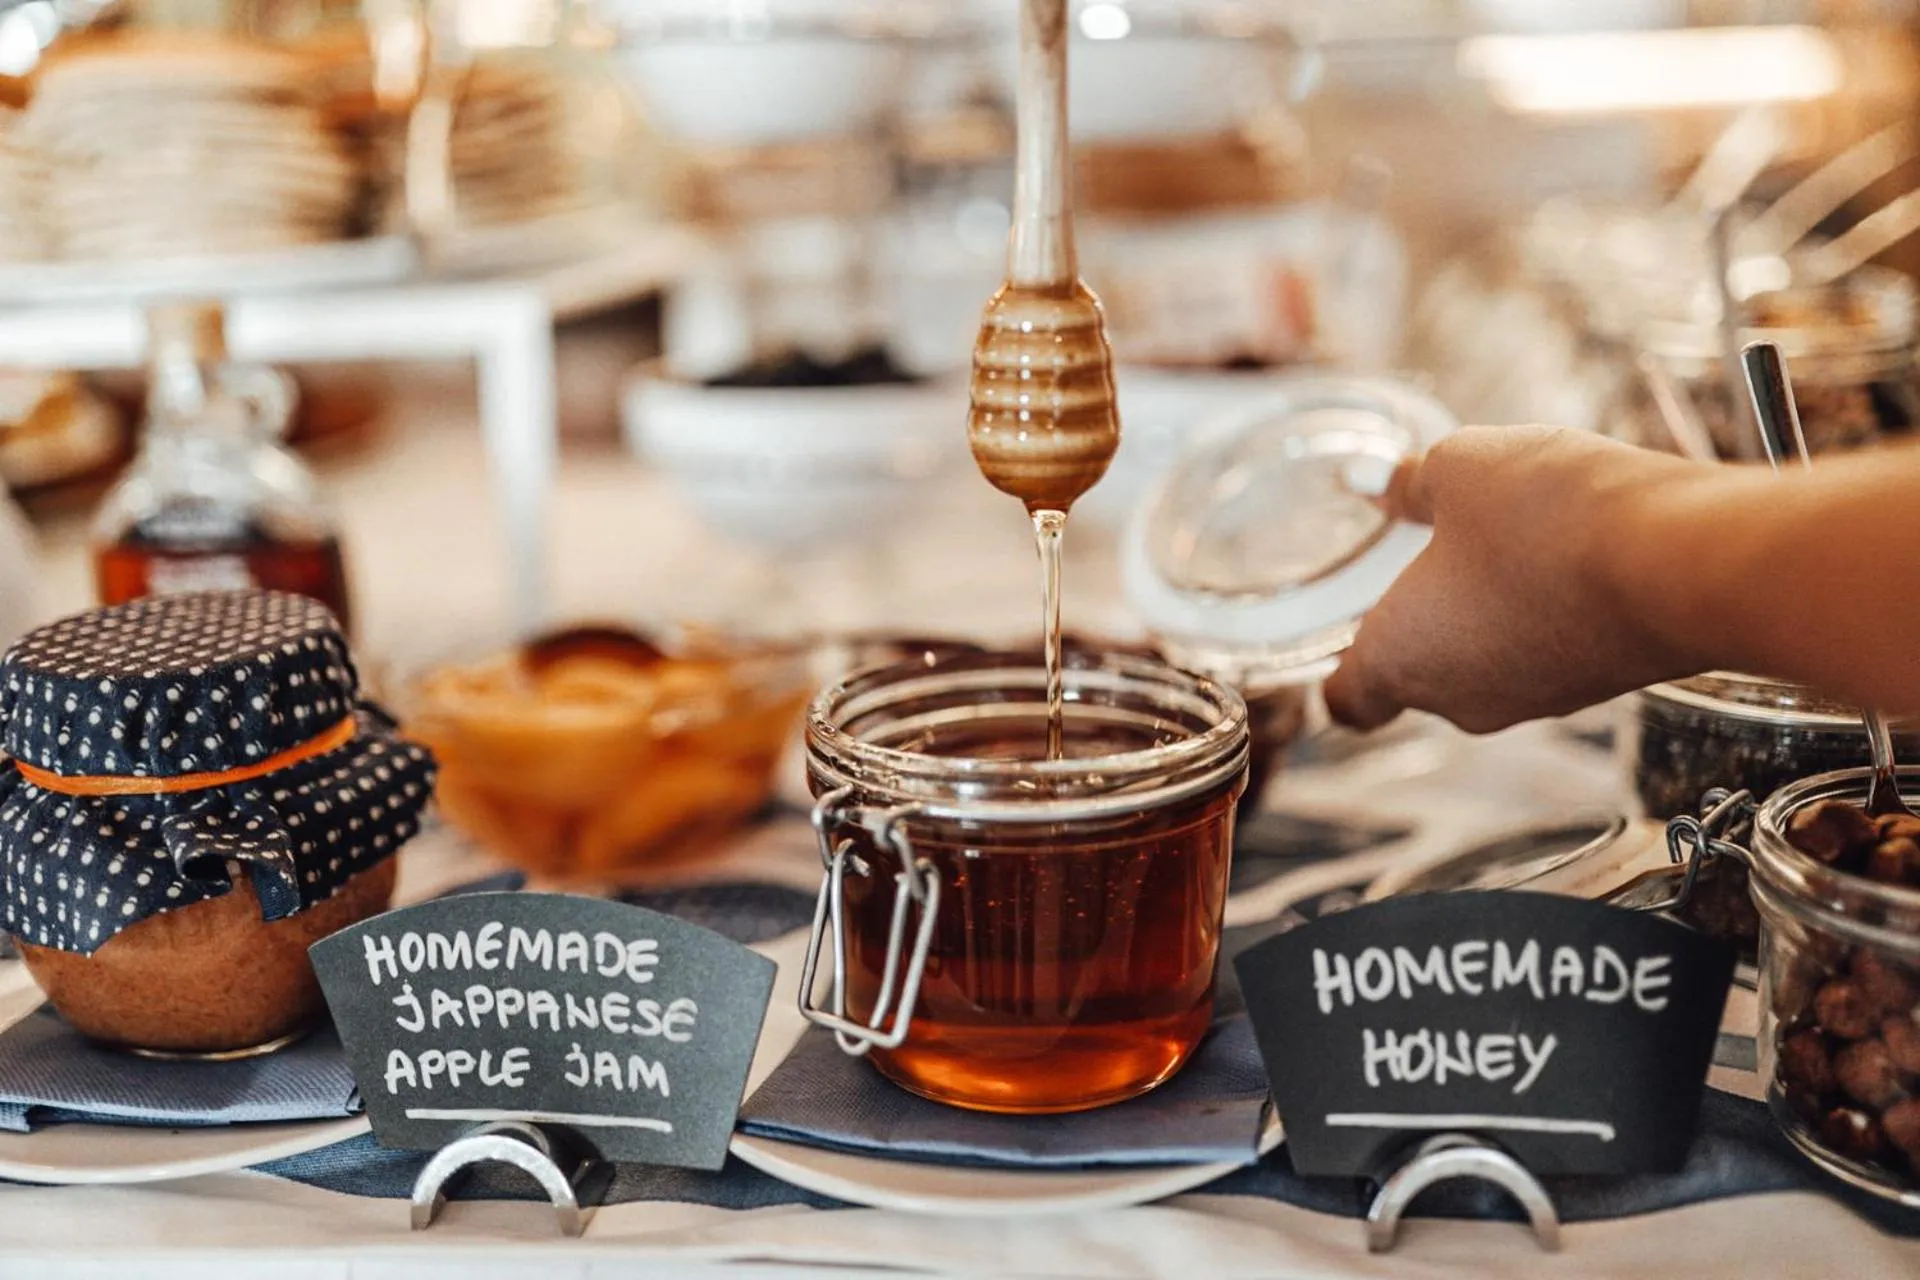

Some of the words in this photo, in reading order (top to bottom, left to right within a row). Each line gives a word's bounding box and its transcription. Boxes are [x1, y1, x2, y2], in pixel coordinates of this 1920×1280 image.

[363, 922, 659, 985] HOMEMADE
[1313, 939, 1671, 1014] HOMEMADE
[384, 1048, 531, 1095] APPLE
[1363, 1028, 1557, 1093] HONEY
